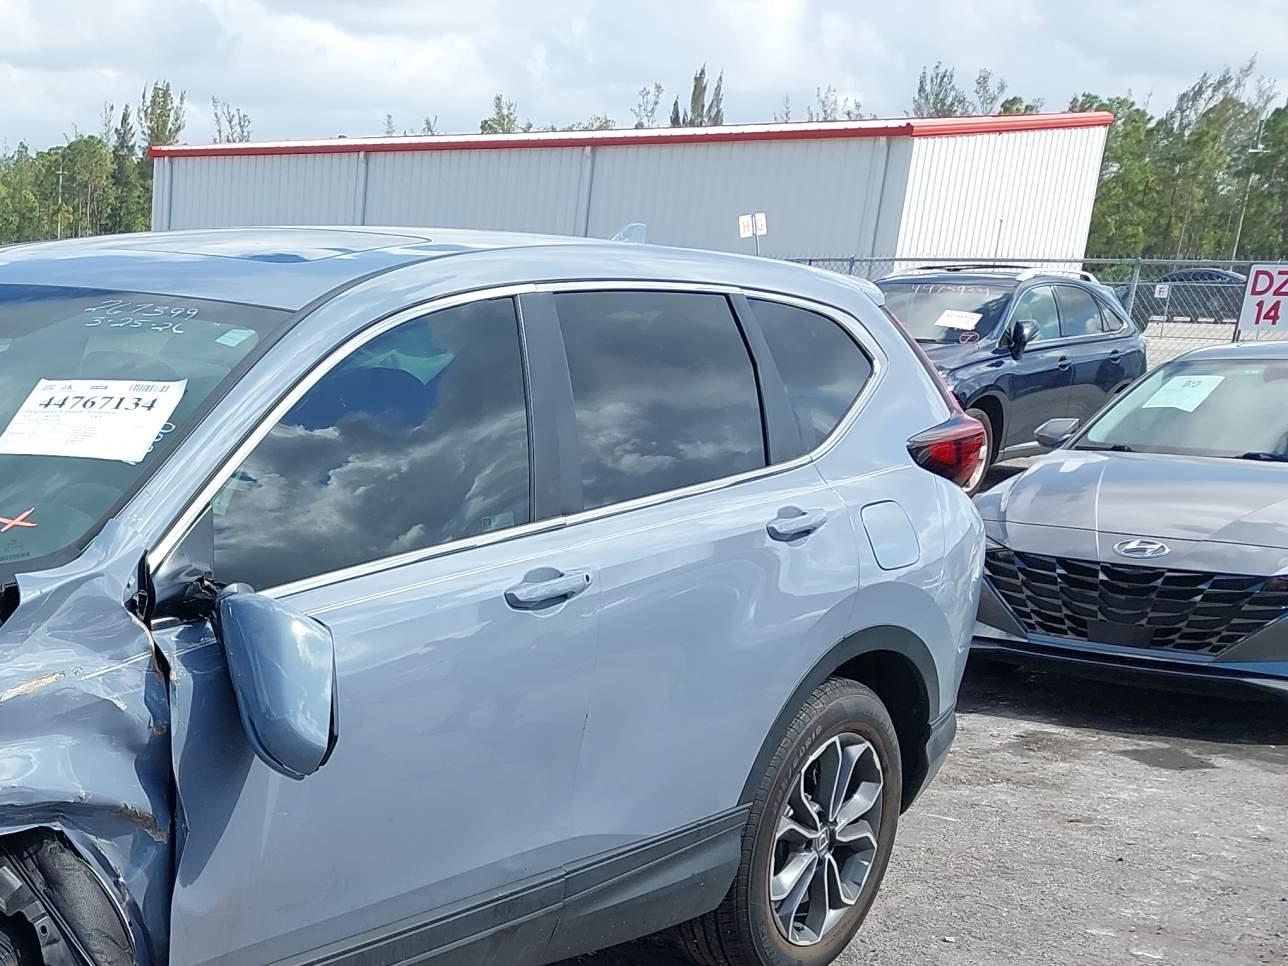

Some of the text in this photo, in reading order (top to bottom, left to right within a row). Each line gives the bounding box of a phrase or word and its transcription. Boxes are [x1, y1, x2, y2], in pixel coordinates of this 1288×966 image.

[1250, 270, 1288, 296] DZ
[1254, 300, 1281, 325] 14
[39, 395, 158, 411] 44767134
